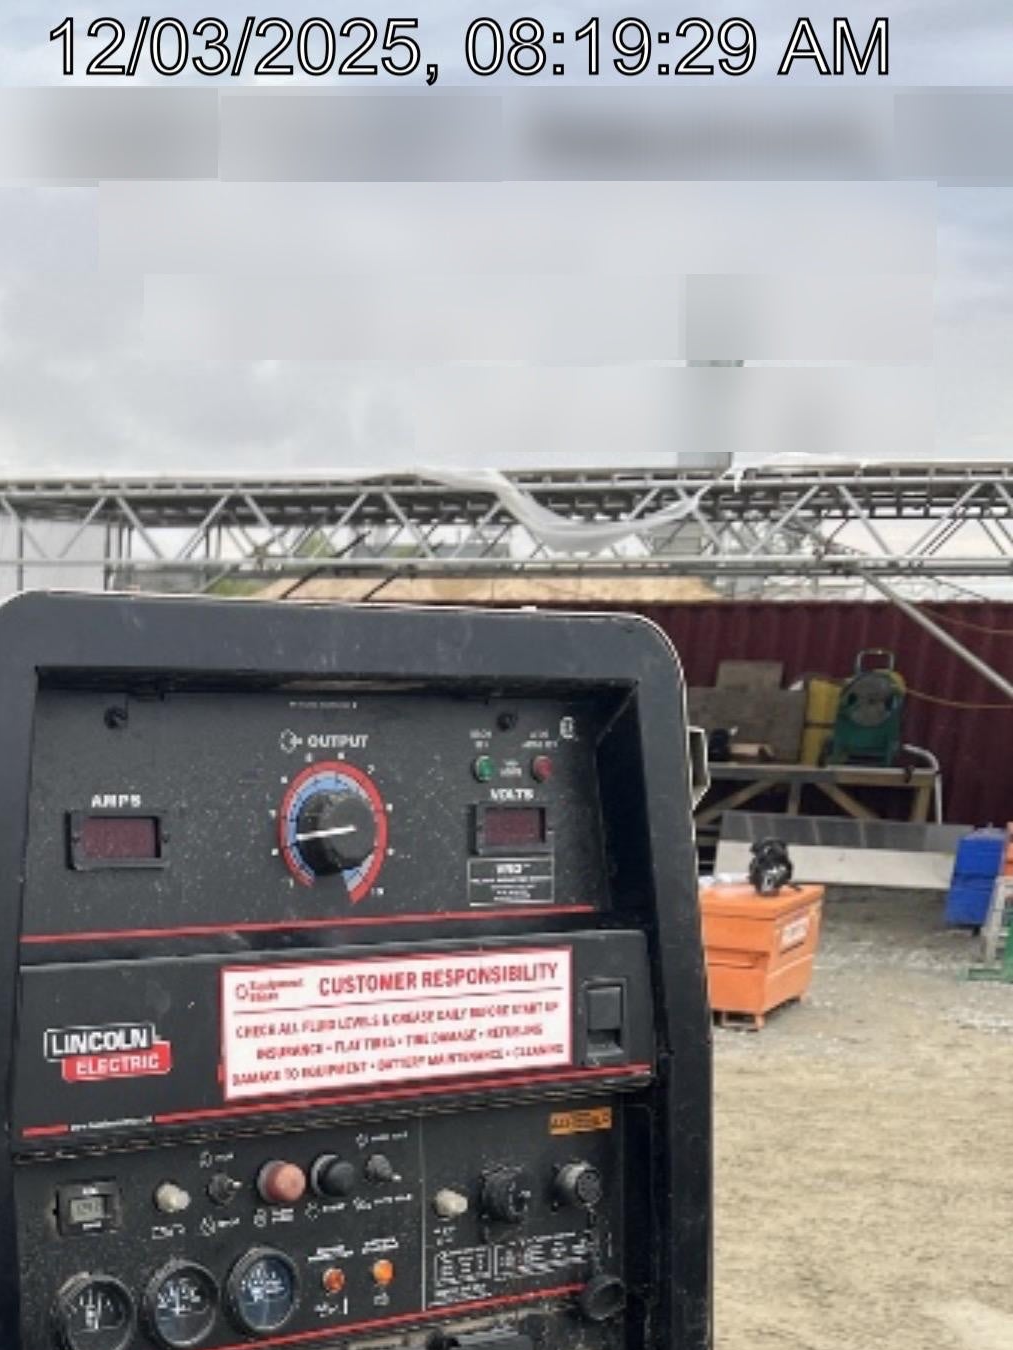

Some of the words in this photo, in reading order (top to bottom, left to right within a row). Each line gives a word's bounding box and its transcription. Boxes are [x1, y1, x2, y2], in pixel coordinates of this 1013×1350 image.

[307, 734, 368, 748] OUTPUT
[91, 793, 142, 808] AMPS
[490, 787, 534, 800] VOLTS
[319, 971, 417, 997] CUSTOMER
[421, 962, 559, 988] RESPONSIBILITY
[51, 1027, 149, 1057] LINCOLN
[75, 1052, 161, 1076] ELECTRIC
